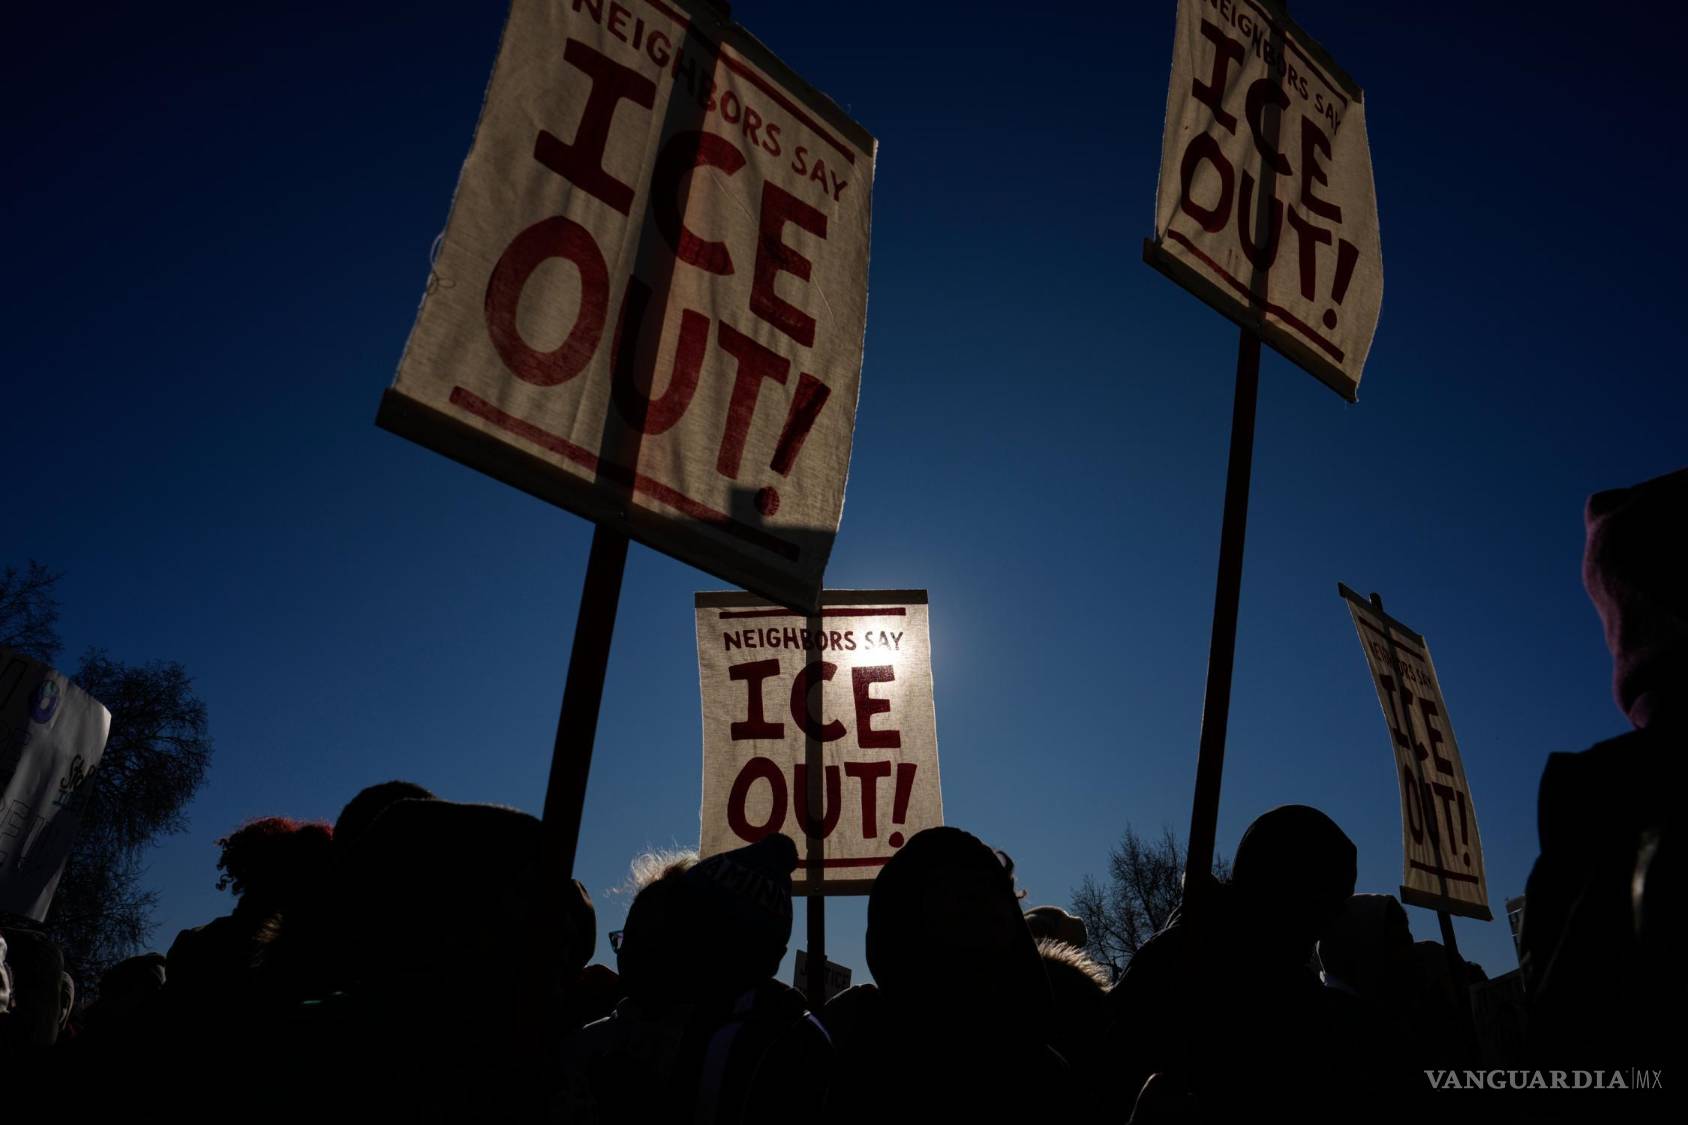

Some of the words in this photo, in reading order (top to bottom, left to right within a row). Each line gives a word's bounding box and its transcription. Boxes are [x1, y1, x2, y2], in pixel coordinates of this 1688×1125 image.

[1192, 18, 1342, 224] ICE
[1315, 94, 1341, 135] SAY
[534, 38, 828, 348] ICE
[790, 145, 849, 202] SAY
[1180, 131, 1359, 330] OUT!
[484, 216, 831, 516] OUT!
[723, 627, 857, 651] NEIGHBORS
[864, 631, 904, 651] SAY
[728, 659, 901, 749] ICE
[1379, 674, 1454, 777] ICE
[727, 757, 917, 848] OUT!
[1404, 764, 1471, 868] OUT!
